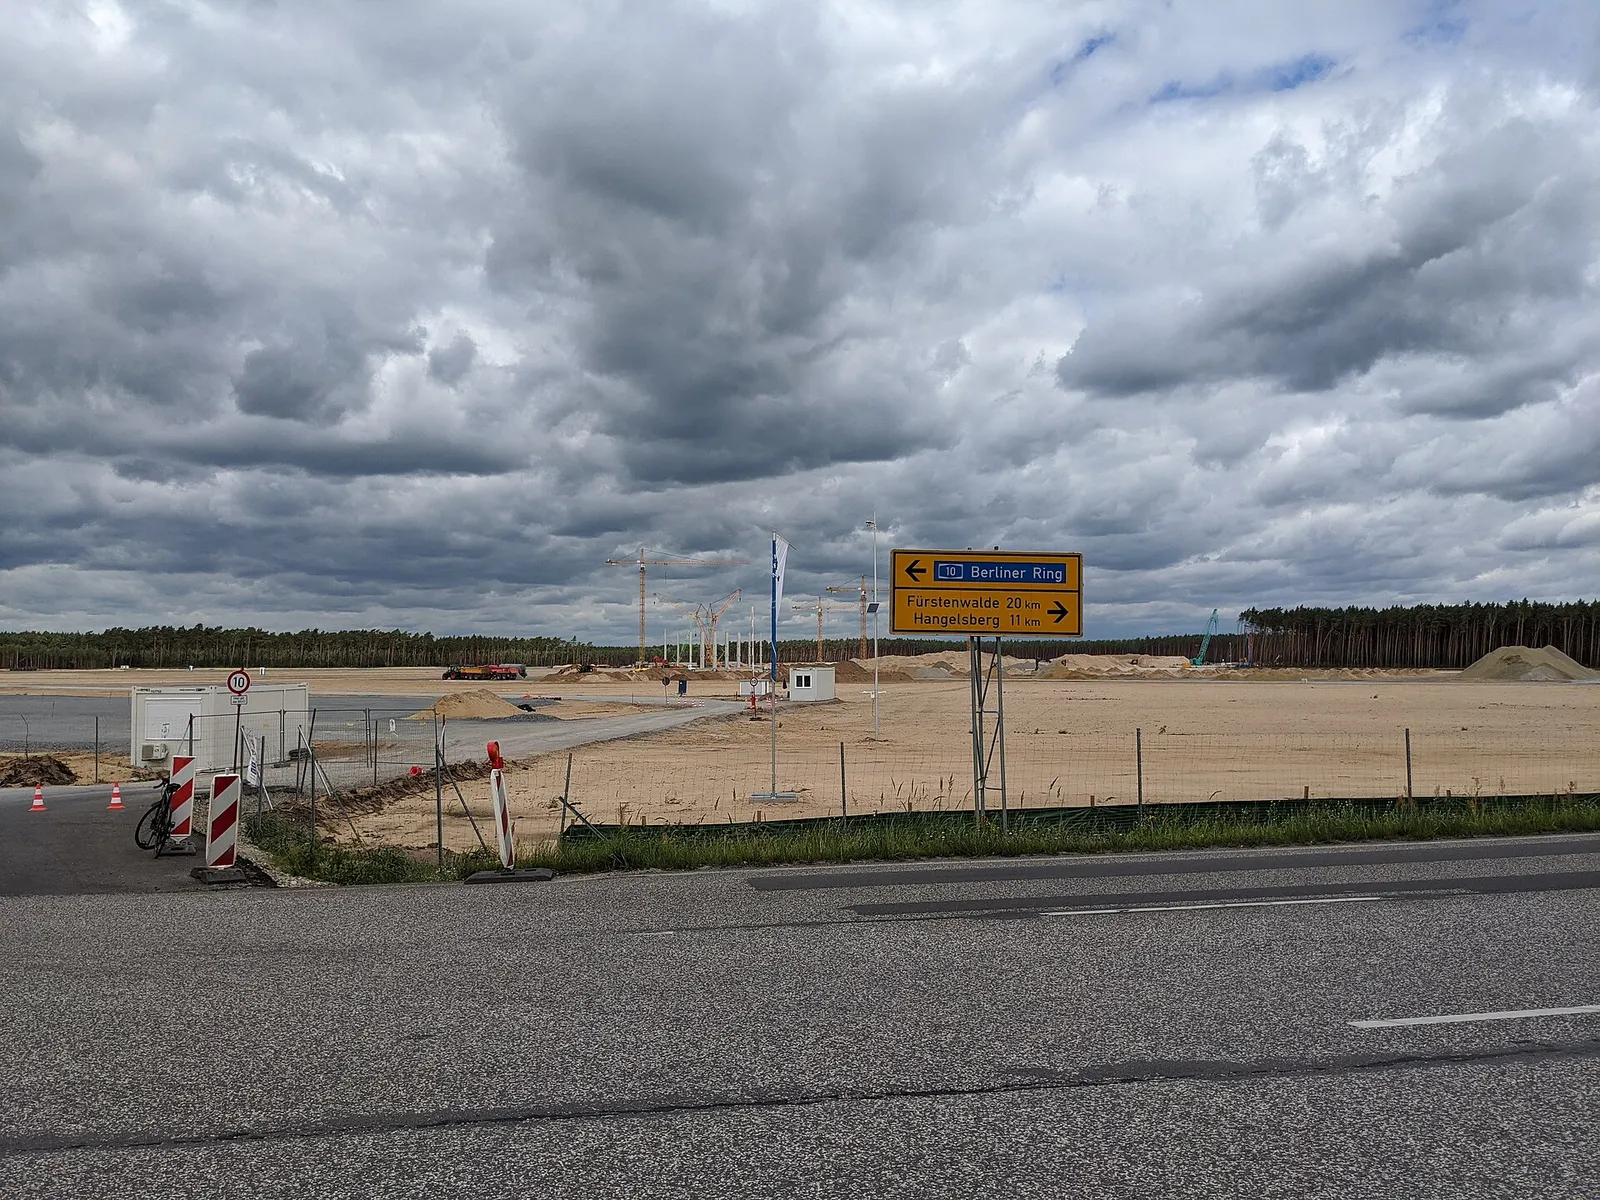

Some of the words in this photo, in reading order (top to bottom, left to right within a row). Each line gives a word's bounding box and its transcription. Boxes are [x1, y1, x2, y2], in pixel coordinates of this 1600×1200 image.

[946, 566, 956, 577] 10
[971, 566, 1026, 579] Berliner
[1033, 567, 1063, 582] Ring
[907, 595, 1000, 609] Fürstenwalde
[1006, 597, 1022, 609] 20
[1025, 600, 1041, 609] km
[914, 612, 1000, 628] Hangelsberg
[1010, 614, 1021, 626] 11
[1025, 617, 1041, 626] km
[233, 676, 245, 688] 10
